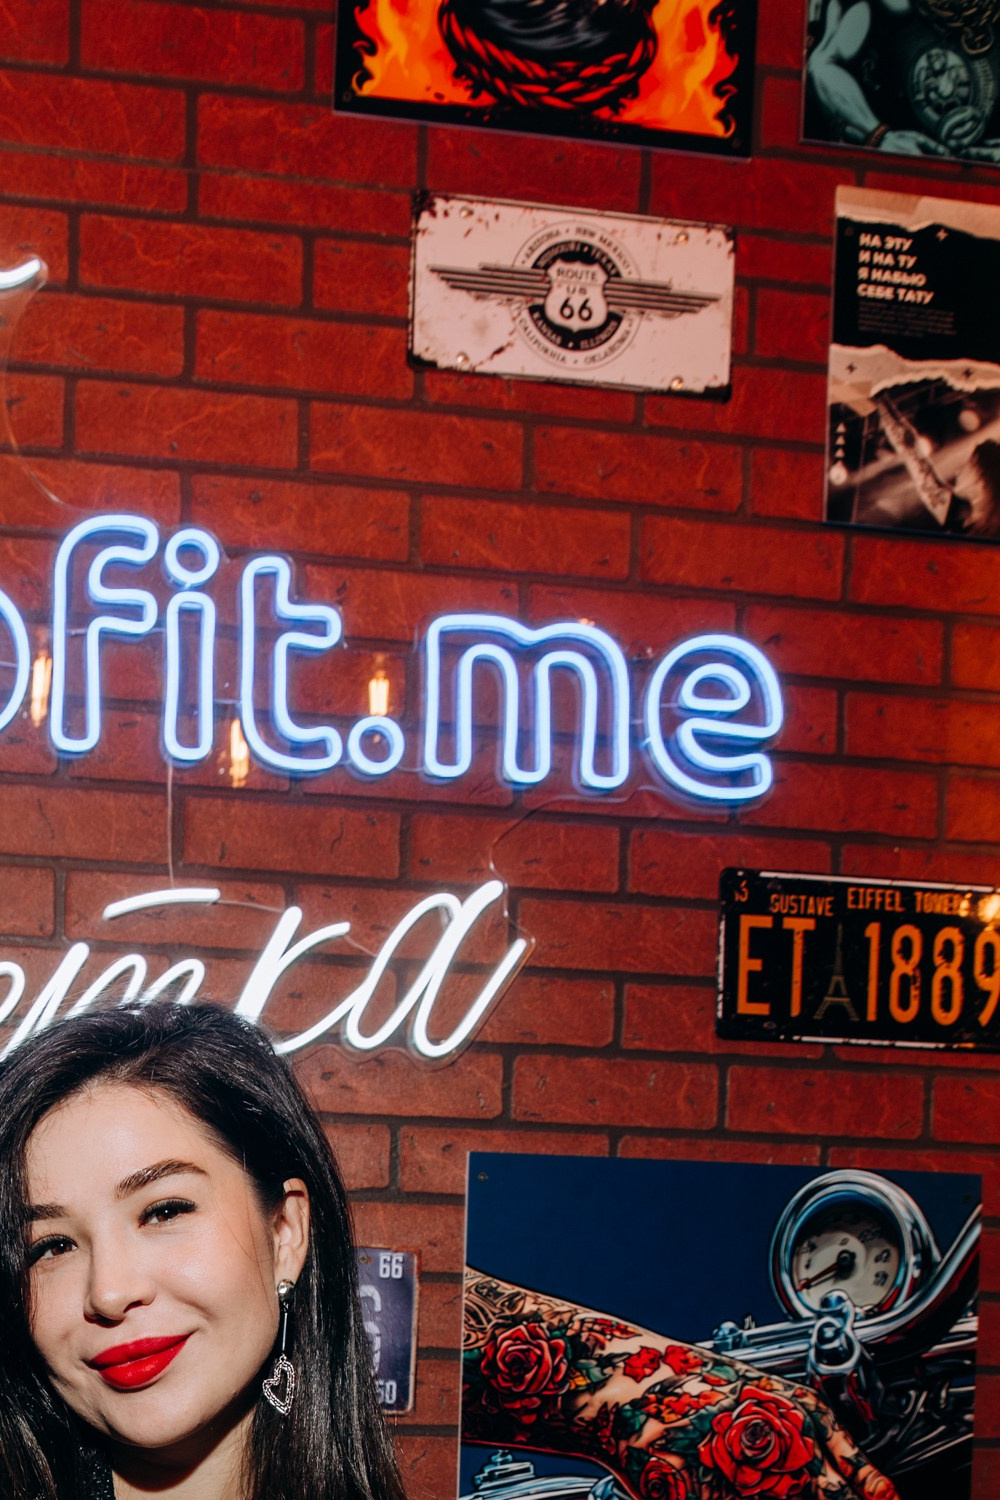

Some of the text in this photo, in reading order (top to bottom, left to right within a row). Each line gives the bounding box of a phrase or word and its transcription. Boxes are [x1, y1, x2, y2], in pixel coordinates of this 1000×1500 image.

[859, 233, 882, 248] НА
[873, 251, 895, 266] НА
[897, 254, 917, 269] ТУ
[556, 268, 598, 282] ROUTE
[857, 283, 935, 305] СЕБЕ ТАТУ
[560, 297, 593, 322] 66
[770, 893, 834, 917] GUSTAVE
[847, 887, 905, 912] EIFFEL
[737, 914, 1000, 1027] ET 1889
[379, 1253, 404, 1279] 66
